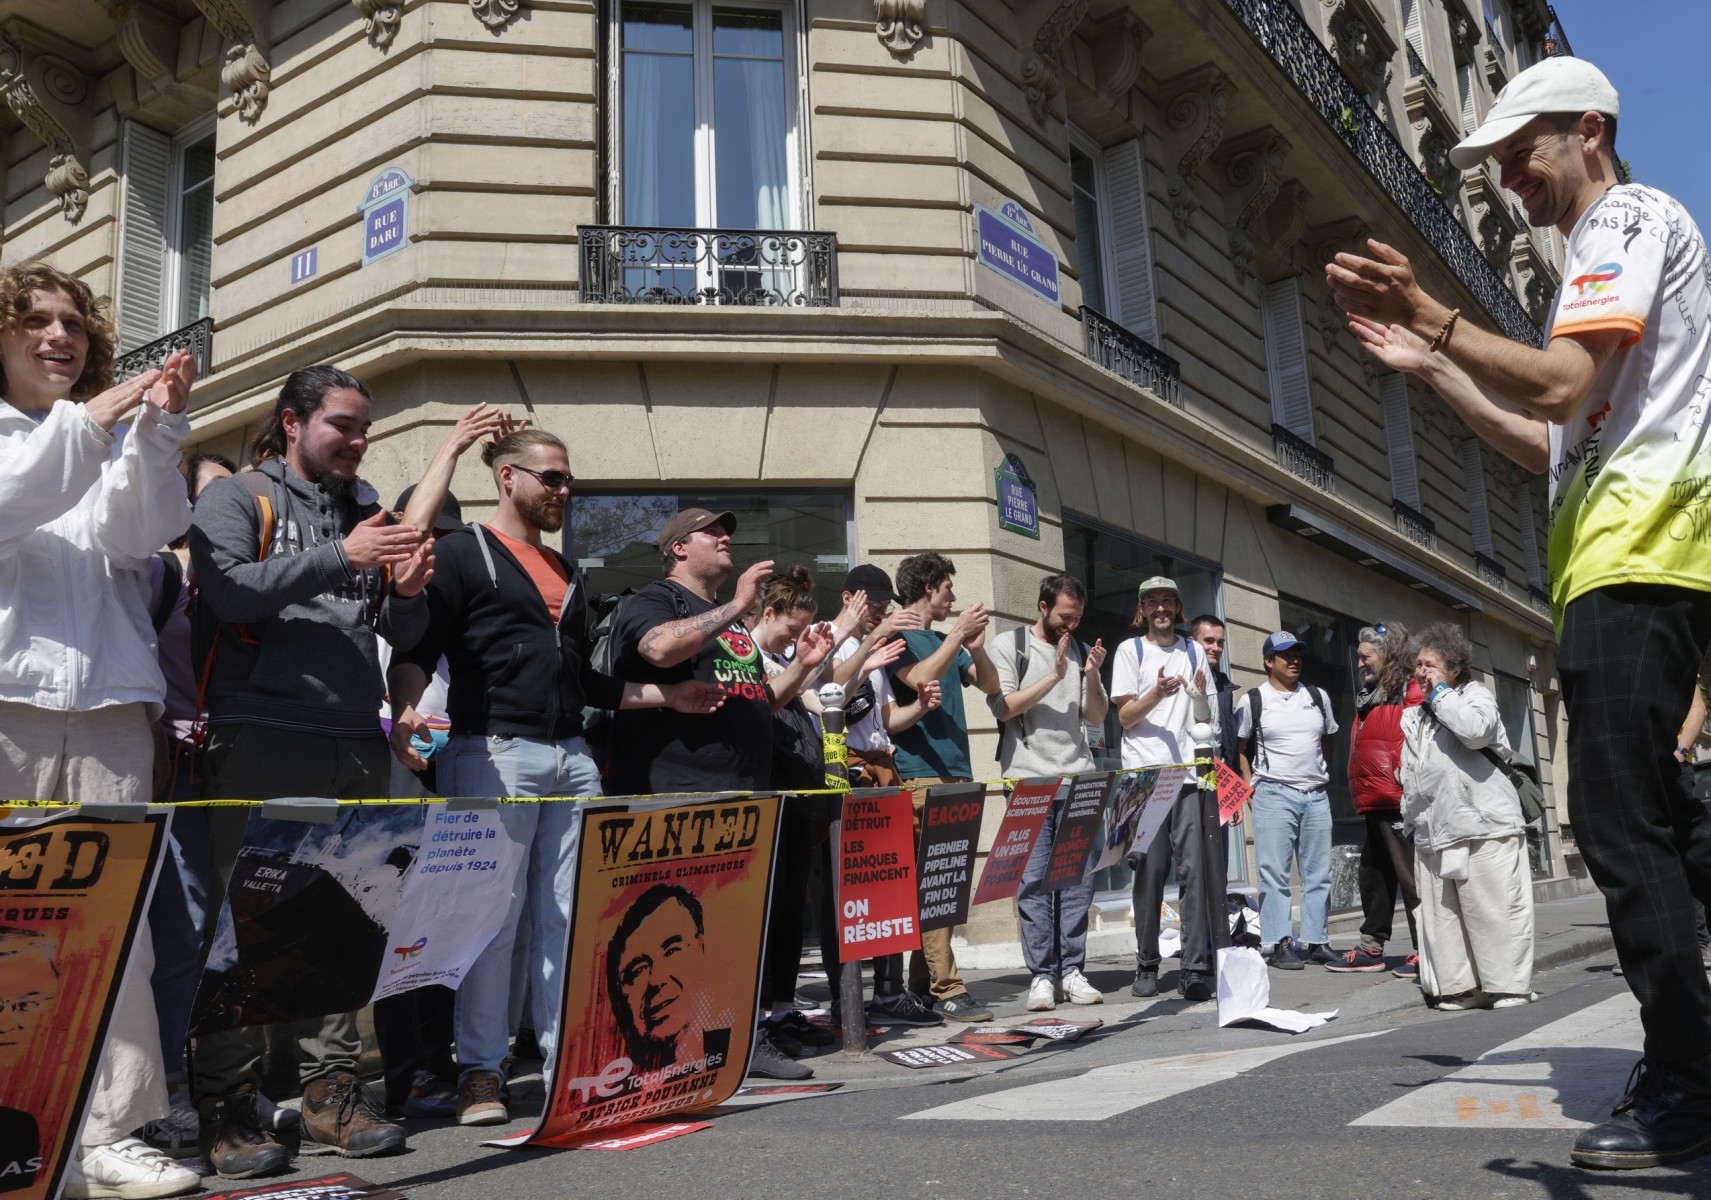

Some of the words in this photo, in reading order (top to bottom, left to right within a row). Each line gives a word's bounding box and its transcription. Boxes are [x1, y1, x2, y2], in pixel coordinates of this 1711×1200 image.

[374, 210, 397, 231] RUE
[370, 226, 400, 249] DARU
[1011, 239, 1029, 258] RUE
[982, 239, 1015, 267] PIERRE
[1017, 260, 1029, 276] LE
[1031, 269, 1057, 293] GRAND
[1563, 294, 1620, 311] TotalEnergies
[1011, 484, 1023, 498] RUE
[1008, 496, 1029, 512] PIERRE
[1005, 507, 1013, 519] LE
[1013, 510, 1033, 525] GRAND
[714, 669, 758, 684] WILL
[1220, 773, 1234, 788] LES
[1225, 787, 1248, 809] TOTAL
[846, 802, 880, 816] TOTAL
[928, 802, 981, 827] EACOP
[435, 813, 461, 824] Fier
[463, 812, 479, 823] de
[845, 815, 891, 831] DÉTRUIT
[432, 829, 482, 842] détruire
[485, 828, 496, 839] la
[599, 805, 760, 864] WANTED
[1007, 829, 1031, 843] PLUS
[1070, 826, 1083, 838] LE
[427, 847, 476, 860] planète
[844, 840, 864, 854] LES
[927, 839, 969, 857] DERNIER
[994, 846, 1010, 858] UN
[1008, 841, 1030, 856] SEUL
[1055, 837, 1089, 854] MONDE
[420, 861, 463, 874] depuis
[467, 861, 497, 870] 1924
[844, 852, 898, 870] BANQUES
[924, 855, 967, 874] PIPELINE
[1052, 852, 1084, 868] SELON
[255, 867, 288, 880] ERIKA
[612, 870, 671, 888] CRIMINELS
[676, 860, 745, 878] CLIMATIQUES
[843, 867, 910, 886] FINANCENT
[920, 874, 953, 890] AVANT
[953, 870, 967, 884] LA
[1050, 866, 1078, 880] TOTAL
[243, 879, 282, 893] VALLETTA
[924, 889, 944, 904] FIN
[942, 887, 957, 901] DU
[843, 899, 869, 918] ON
[920, 902, 957, 921] MONDE
[844, 917, 913, 944] RÉSISTE
[627, 1052, 722, 1090] TotalEnergies
[575, 1093, 645, 1124] PATRICK
[643, 1070, 718, 1105] POUYANNÉ
[588, 1118, 608, 1129] LE
[610, 1095, 695, 1123] FOSSOYEUR
